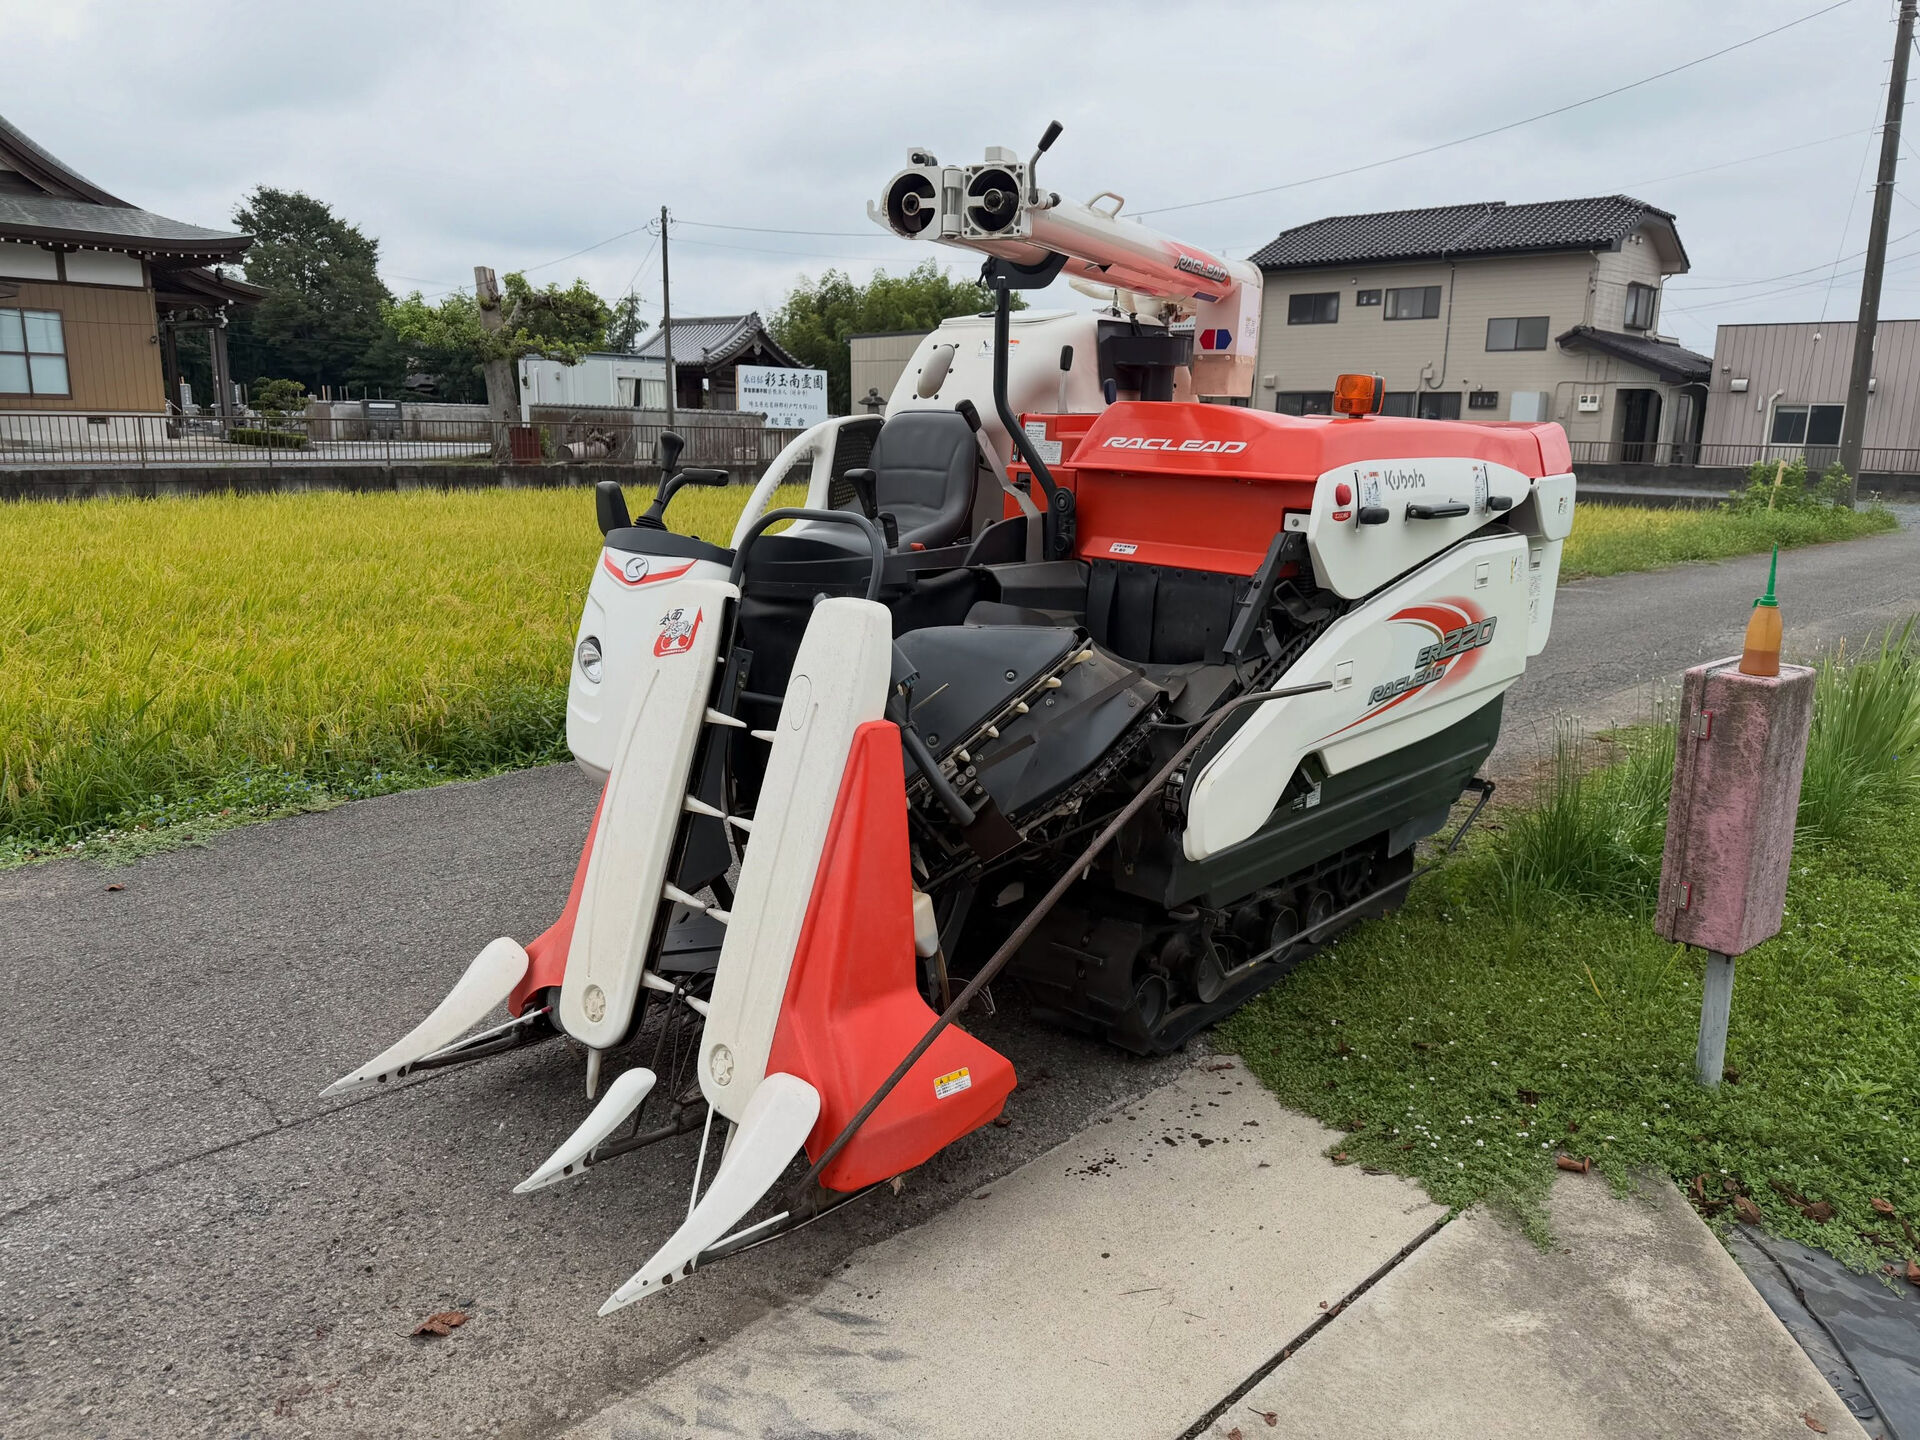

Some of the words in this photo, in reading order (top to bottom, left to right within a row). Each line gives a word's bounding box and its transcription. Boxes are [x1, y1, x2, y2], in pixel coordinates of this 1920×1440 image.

[1174, 254, 1228, 283] RACLEAD
[1102, 436, 1248, 454] RACLEAD
[1384, 468, 1426, 491] Kubota
[1414, 616, 1497, 669] ER220
[1367, 663, 1447, 706] RACLEAD
